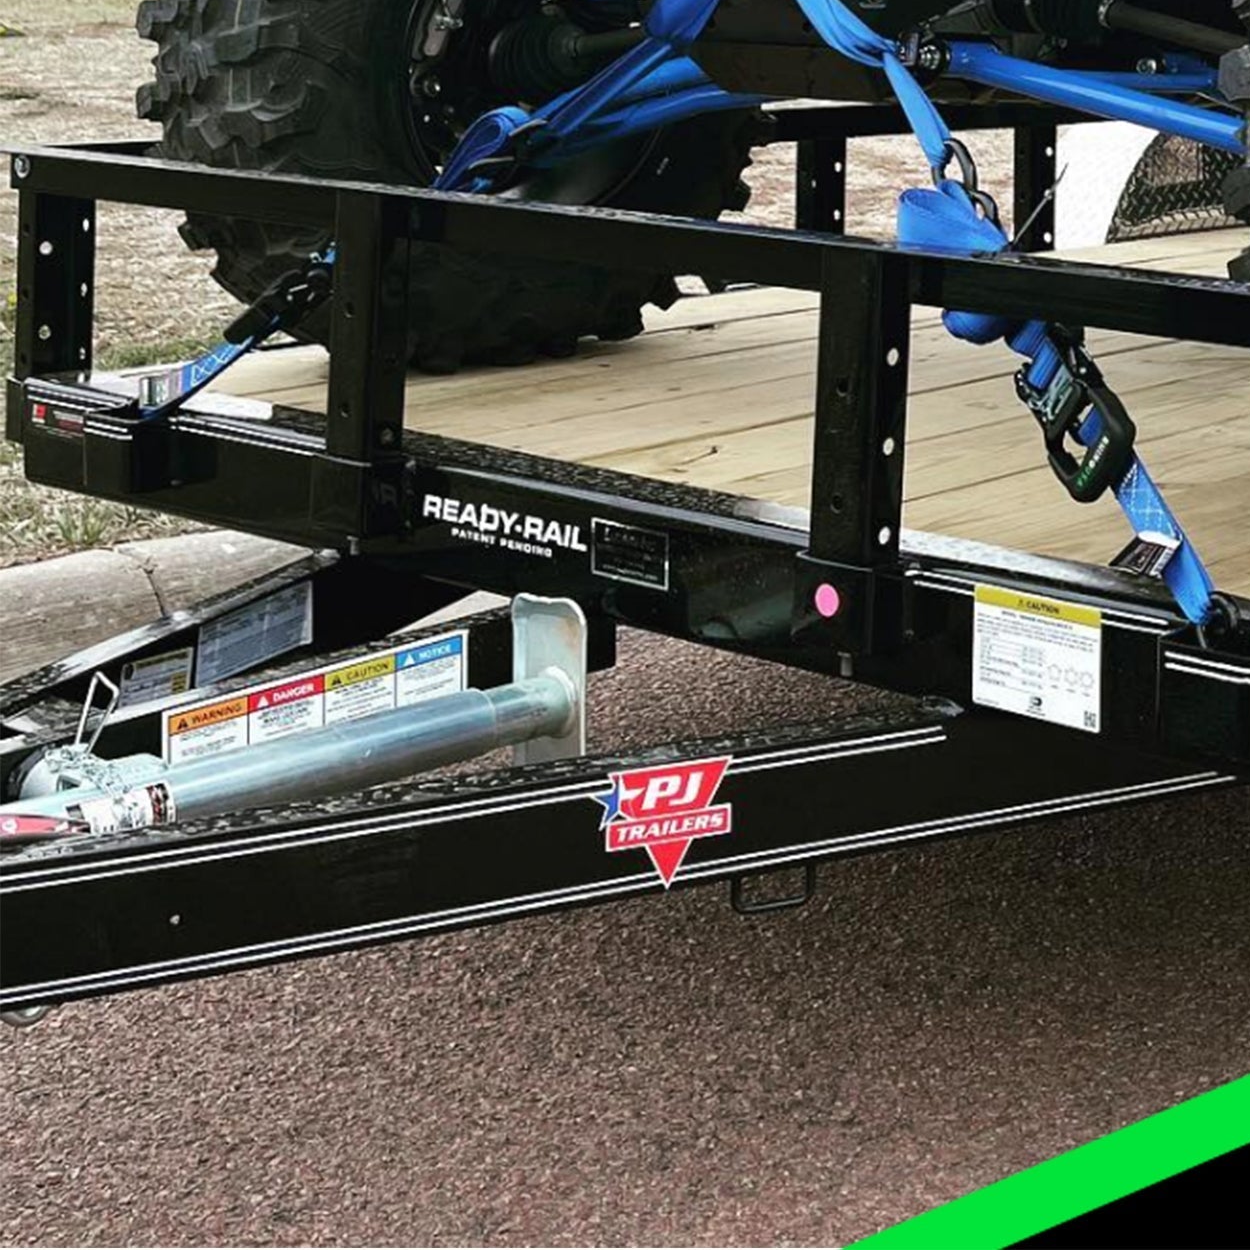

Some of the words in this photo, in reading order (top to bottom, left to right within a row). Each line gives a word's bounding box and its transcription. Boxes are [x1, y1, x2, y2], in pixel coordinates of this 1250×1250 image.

[451, 527, 496, 546] PATENT
[499, 537, 553, 558] PENDING
[418, 643, 451, 660] NOTICE
[345, 660, 389, 681] CAUTION
[272, 682, 315, 703] DANGER
[191, 702, 243, 724] WARNING
[641, 771, 704, 811] PJ
[616, 811, 725, 843] TRAILERS
